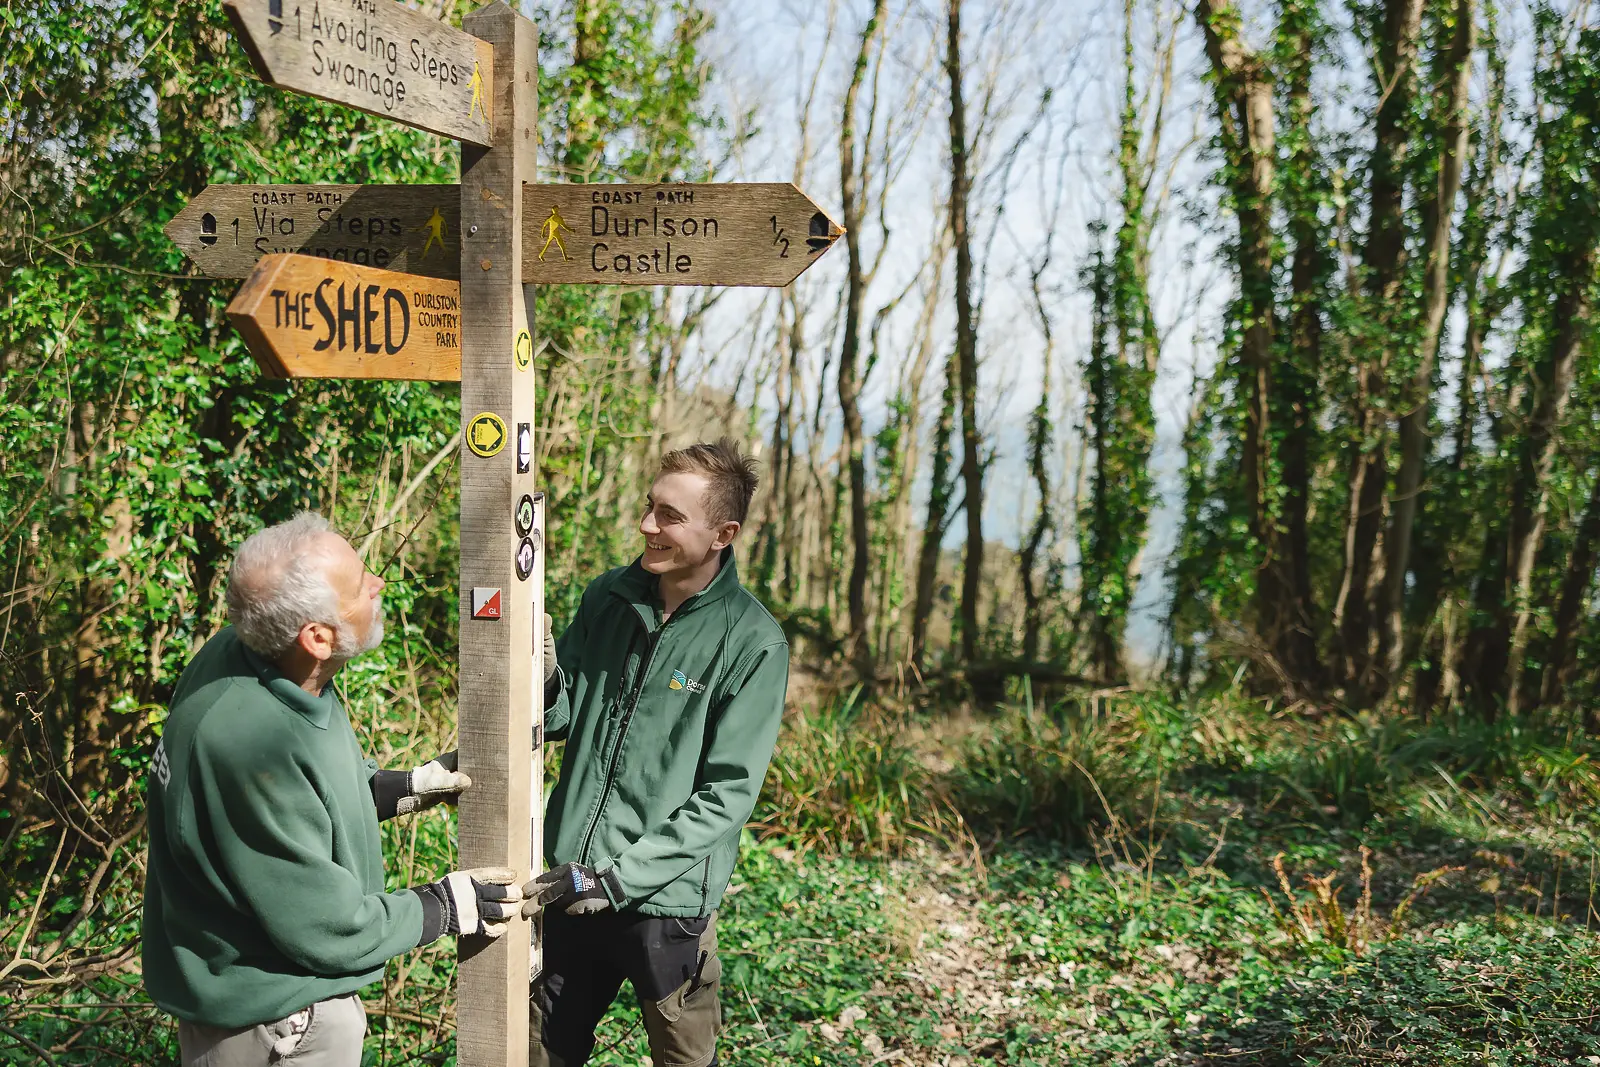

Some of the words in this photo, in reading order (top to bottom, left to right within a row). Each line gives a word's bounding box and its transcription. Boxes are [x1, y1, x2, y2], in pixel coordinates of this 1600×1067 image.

[294, 6, 301, 41] 1
[311, 1, 398, 76] Avoiding
[410, 38, 458, 90] Steps
[311, 39, 406, 111] Swanage
[252, 192, 296, 205] COAST
[306, 193, 342, 205] PATH
[592, 190, 642, 204] COAST
[656, 190, 694, 204] PATH
[230, 217, 240, 247] 1
[253, 207, 295, 236] Via
[317, 207, 402, 244] Steps
[591, 205, 719, 237] Durlson
[254, 236, 391, 267] Snage
[591, 242, 692, 273] Castle
[270, 289, 315, 331] THE
[313, 277, 411, 356] SHED
[414, 292, 458, 312] DURLSTON
[418, 311, 458, 329] COUNTRY
[436, 332, 458, 348] PARK
[488, 607, 499, 615] GL
